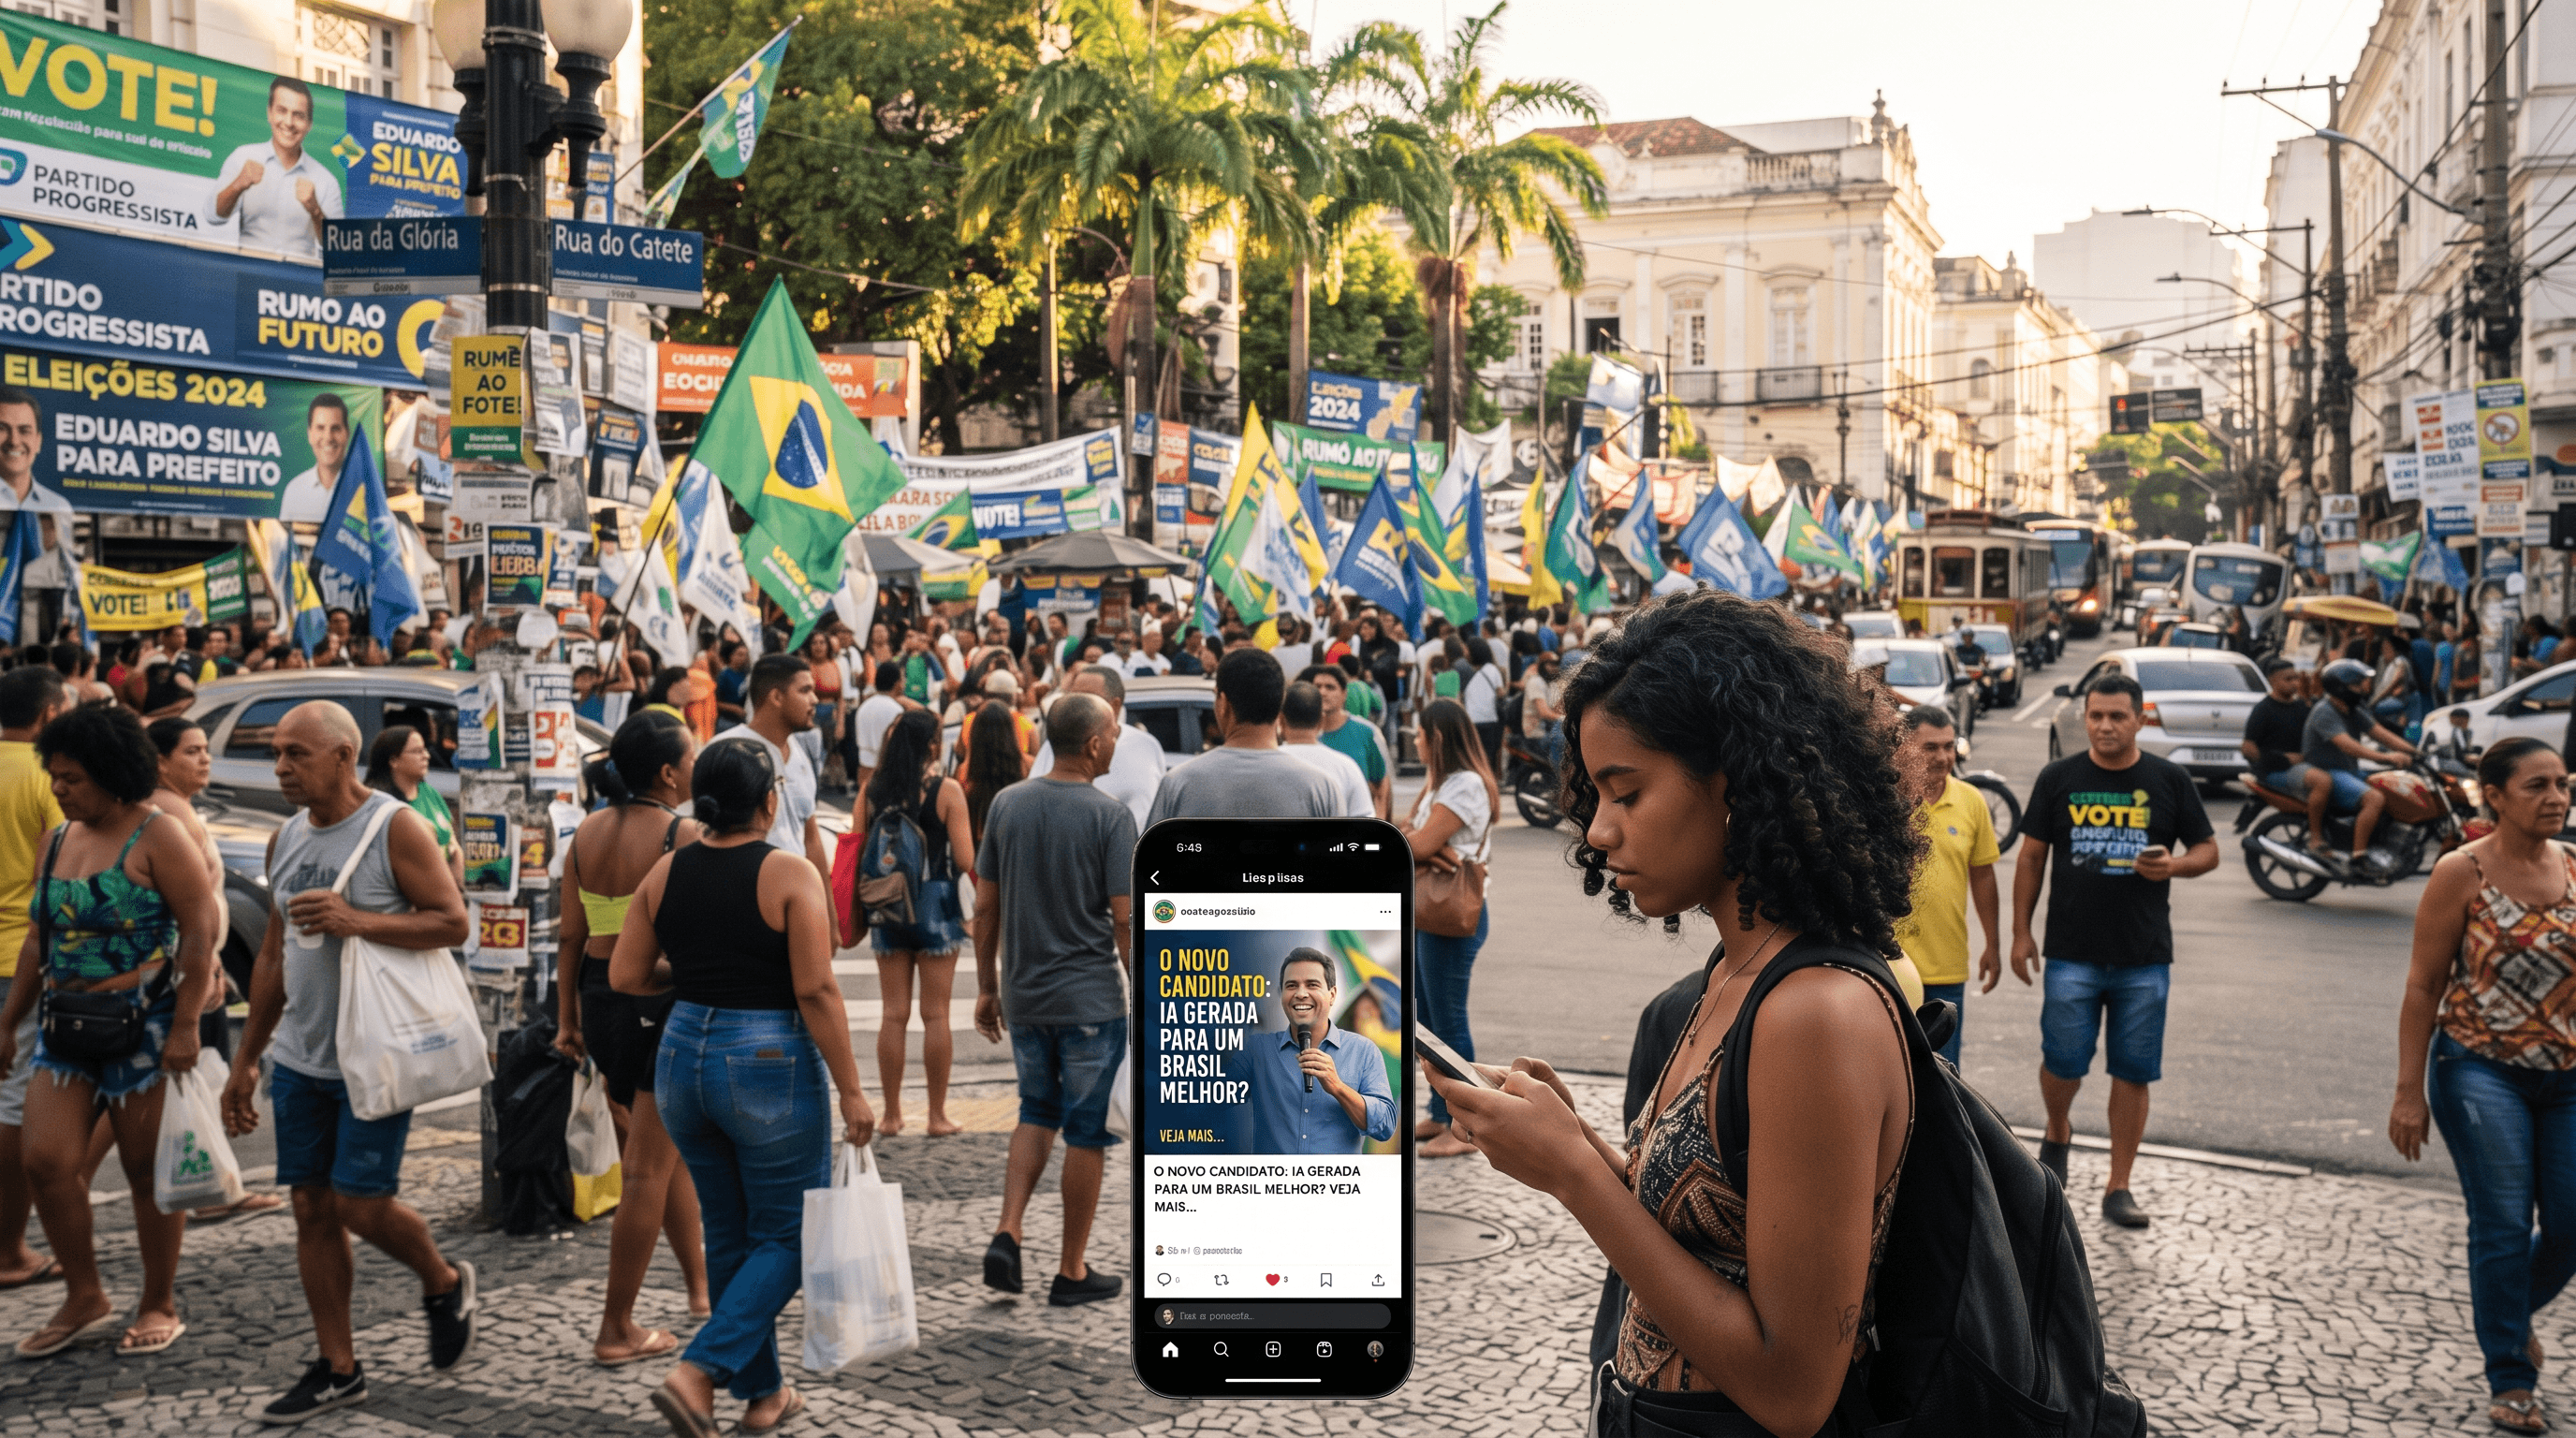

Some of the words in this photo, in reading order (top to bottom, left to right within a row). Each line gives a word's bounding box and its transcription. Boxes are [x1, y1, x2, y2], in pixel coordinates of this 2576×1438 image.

[0, 33, 218, 138] VOTE!
[373, 121, 461, 154] EDUARDO
[371, 141, 461, 186] SILVA
[34, 164, 136, 198] PARTIDO
[33, 187, 198, 230] PROGRESSISTA
[328, 224, 363, 252] Rua
[370, 221, 393, 251] da
[400, 220, 459, 251] Glória
[555, 224, 593, 254] Rua
[599, 227, 624, 257] do
[630, 232, 694, 263] Catete
[0, 272, 103, 312] RTIDO
[257, 288, 342, 323] RUMO
[346, 301, 387, 329] AO
[0, 303, 211, 355] ROGRESSISTA
[257, 316, 384, 358] FUTURO
[4, 353, 178, 401] ELEIÇÕES
[184, 374, 266, 408] 2024
[476, 374, 506, 391] AO
[1309, 395, 1361, 421] 2024
[55, 412, 201, 450] EDUARDO
[206, 428, 281, 457] SILVA
[57, 445, 140, 477] PARA
[147, 452, 280, 487] PREFEITO
[1160, 948, 1172, 972] O
[1178, 948, 1229, 972] NOVO
[1160, 975, 1271, 998] CANDIDATO:
[1160, 1002, 1178, 1024] IA
[1184, 1002, 1259, 1024] GERADA
[1160, 1028, 1208, 1051] PARA
[1215, 1028, 1244, 1051] UM
[1160, 1054, 1226, 1078] BRASIL
[1160, 1081, 1250, 1104] MELHOR?
[1160, 1129, 1185, 1142] VEJA
[1188, 1129, 1224, 1142] MAIS...
[1154, 1167, 1164, 1177] O
[1167, 1167, 1206, 1177] NOVO
[1209, 1167, 1289, 1177] CANDIDATO:
[1292, 1167, 1305, 1177] IA
[1308, 1167, 1361, 1177] GERADA
[1154, 1184, 1188, 1195] PARA
[1192, 1184, 1212, 1195] UM
[1216, 1184, 1261, 1195] BRASIL
[1265, 1184, 1325, 1195] MELHOR?
[1329, 1184, 1361, 1195] VEJA
[1154, 1201, 1197, 1212] MAIS...
